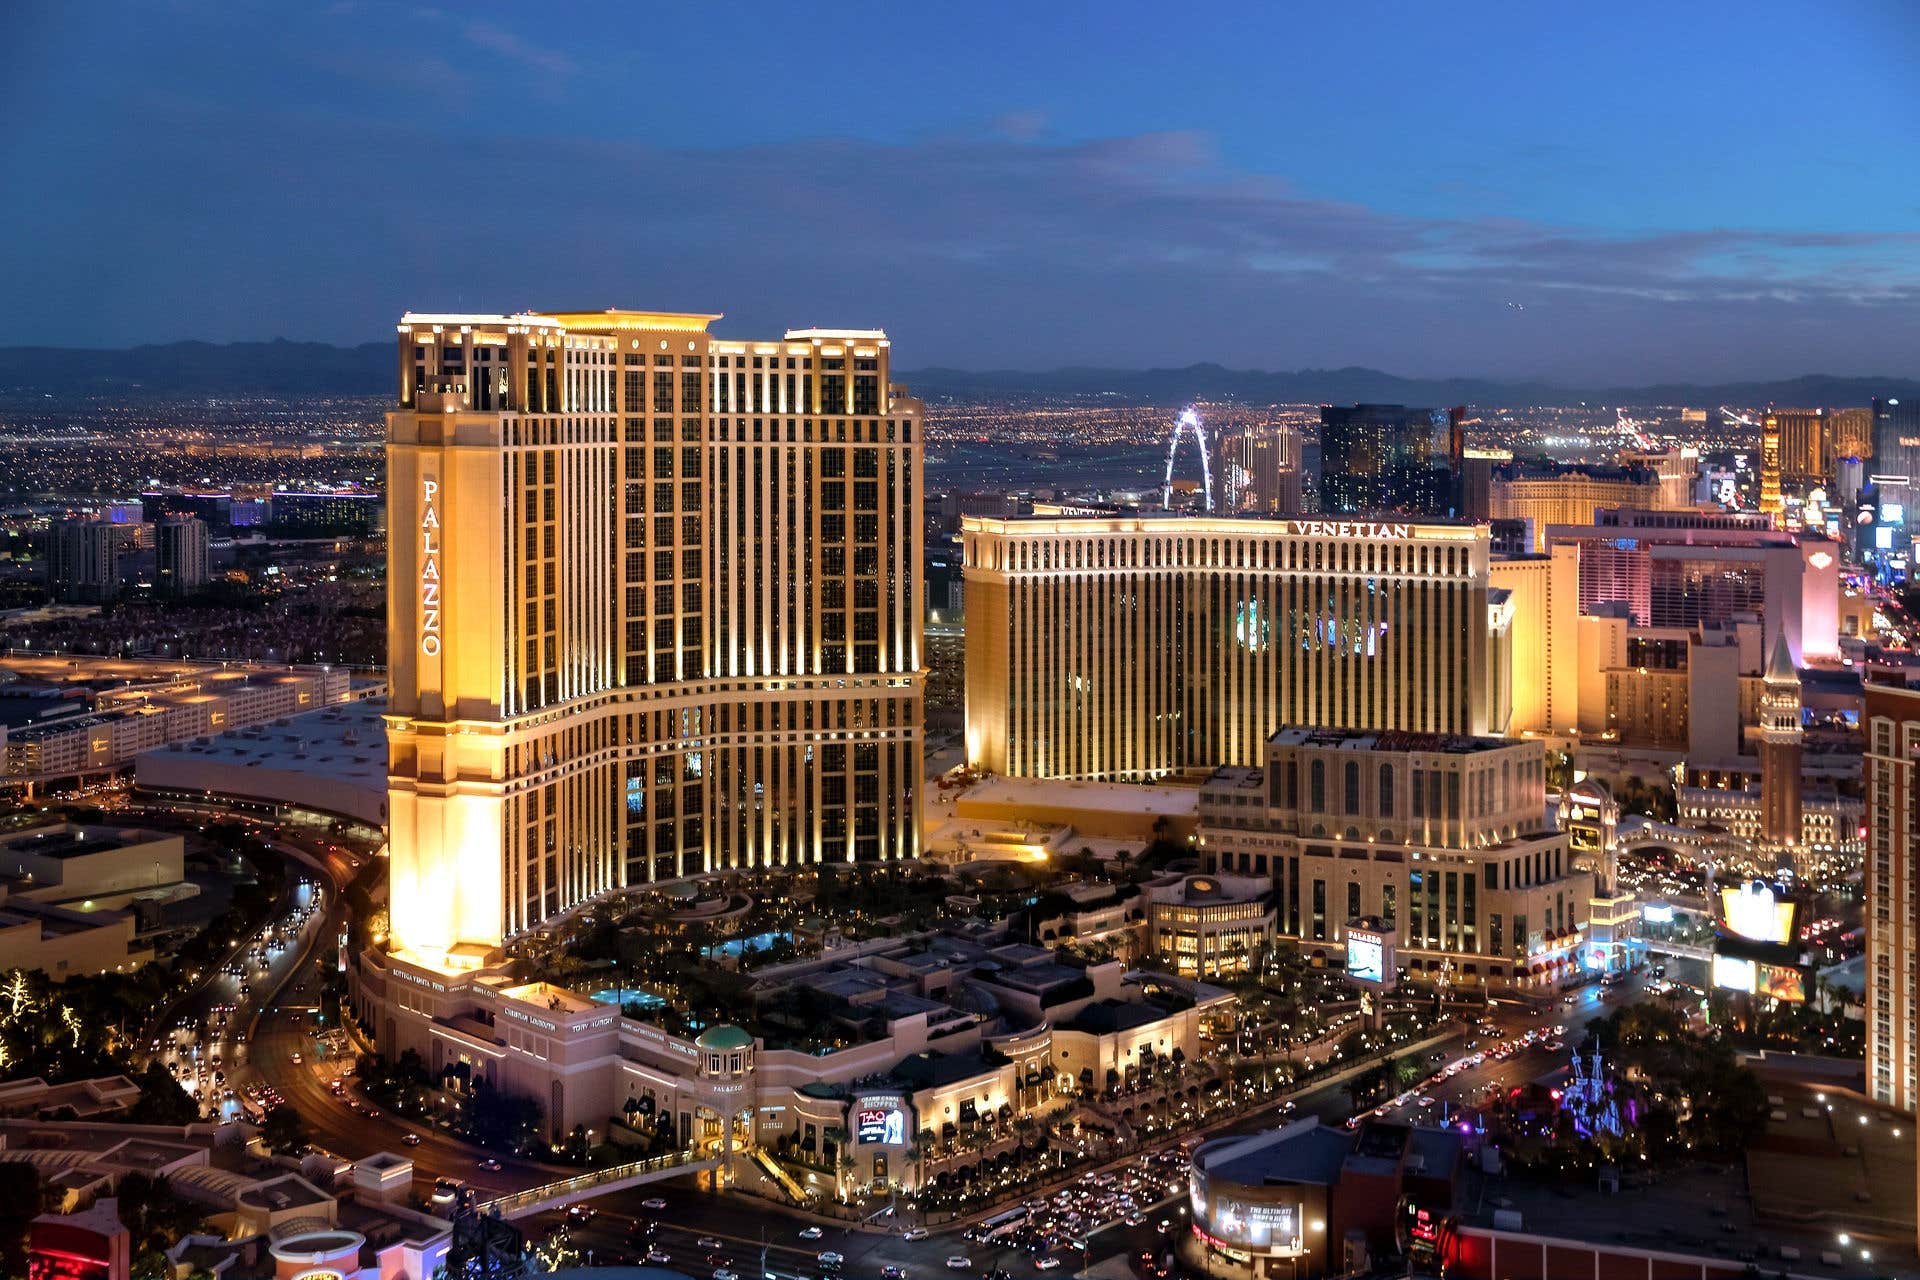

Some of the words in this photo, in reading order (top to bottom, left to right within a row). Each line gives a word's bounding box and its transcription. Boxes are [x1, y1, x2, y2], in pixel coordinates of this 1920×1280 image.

[1294, 520, 1410, 540] VENETIAN
[422, 480, 441, 657] PALAZZO
[1348, 930, 1382, 946] PALAZZO
[713, 1084, 743, 1093] PALAZZO
[859, 1111, 886, 1124] TAO
